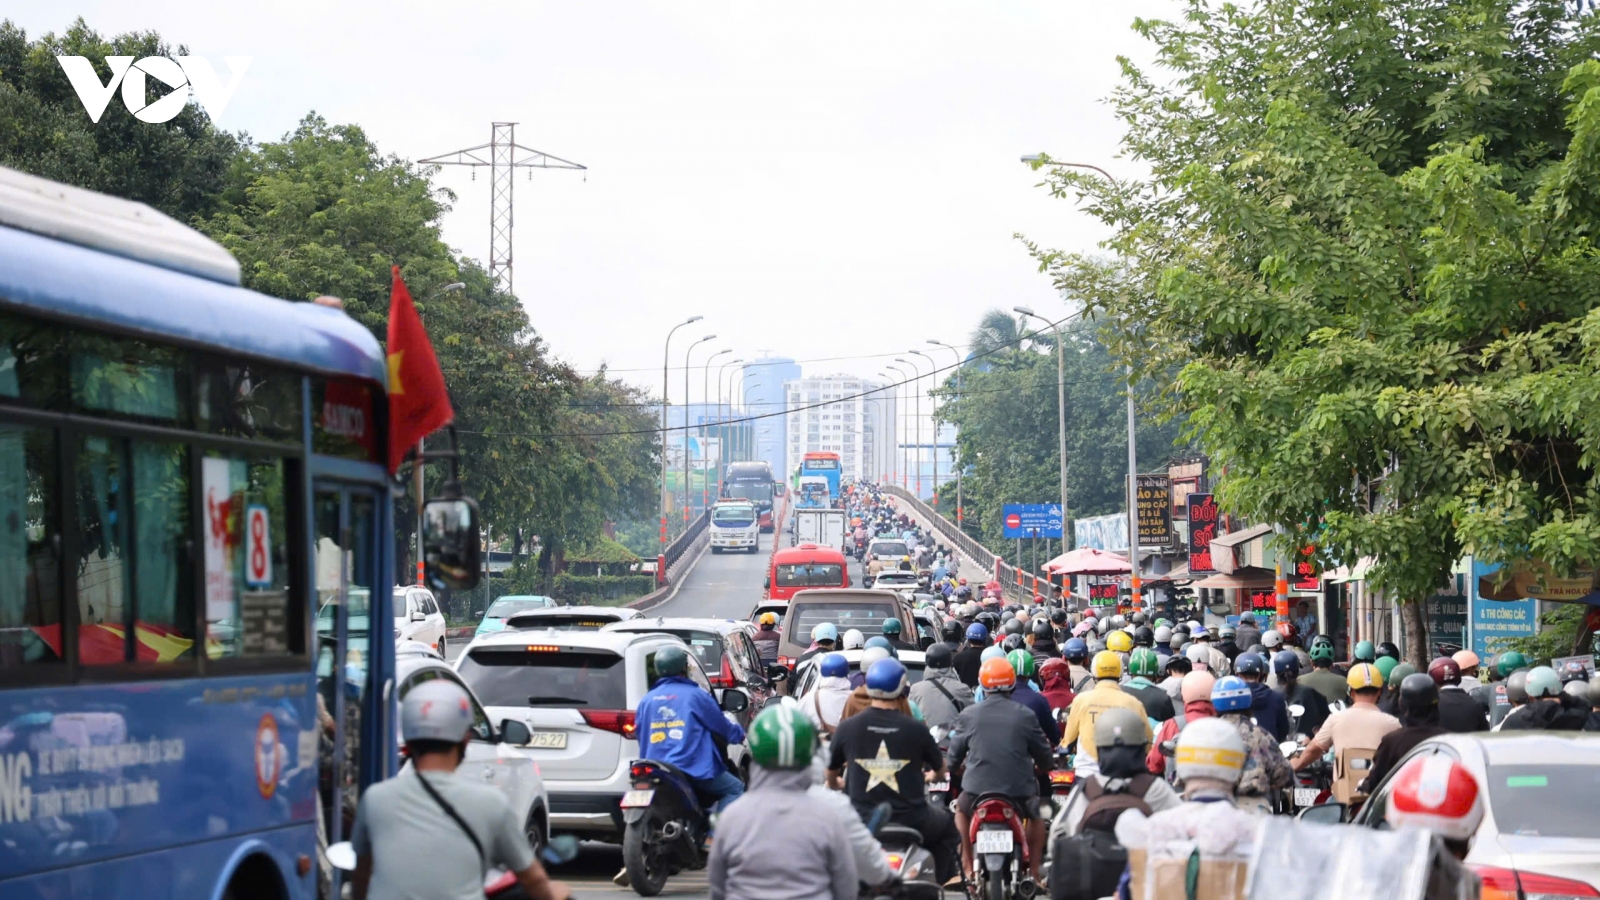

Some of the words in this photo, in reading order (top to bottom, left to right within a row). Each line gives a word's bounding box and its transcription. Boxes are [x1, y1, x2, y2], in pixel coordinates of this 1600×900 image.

[1137, 486, 1151, 499] ẢO
[1153, 490, 1168, 499] AN
[1137, 501, 1152, 509] UNG
[1153, 499, 1168, 509] CẤP
[1191, 496, 1217, 522] ĐỔI
[1151, 526, 1167, 535] CẤP
[1194, 523, 1215, 547] SỐ
[252, 511, 266, 580] 8
[1549, 586, 1564, 595] TRÀ
[1480, 608, 1486, 619] &
[1486, 608, 1496, 619] THI
[1496, 607, 1513, 619] CÔNG
[1513, 608, 1526, 620] CÁC
[1496, 622, 1507, 631] CÔNG
[533, 733, 564, 747] 75.27
